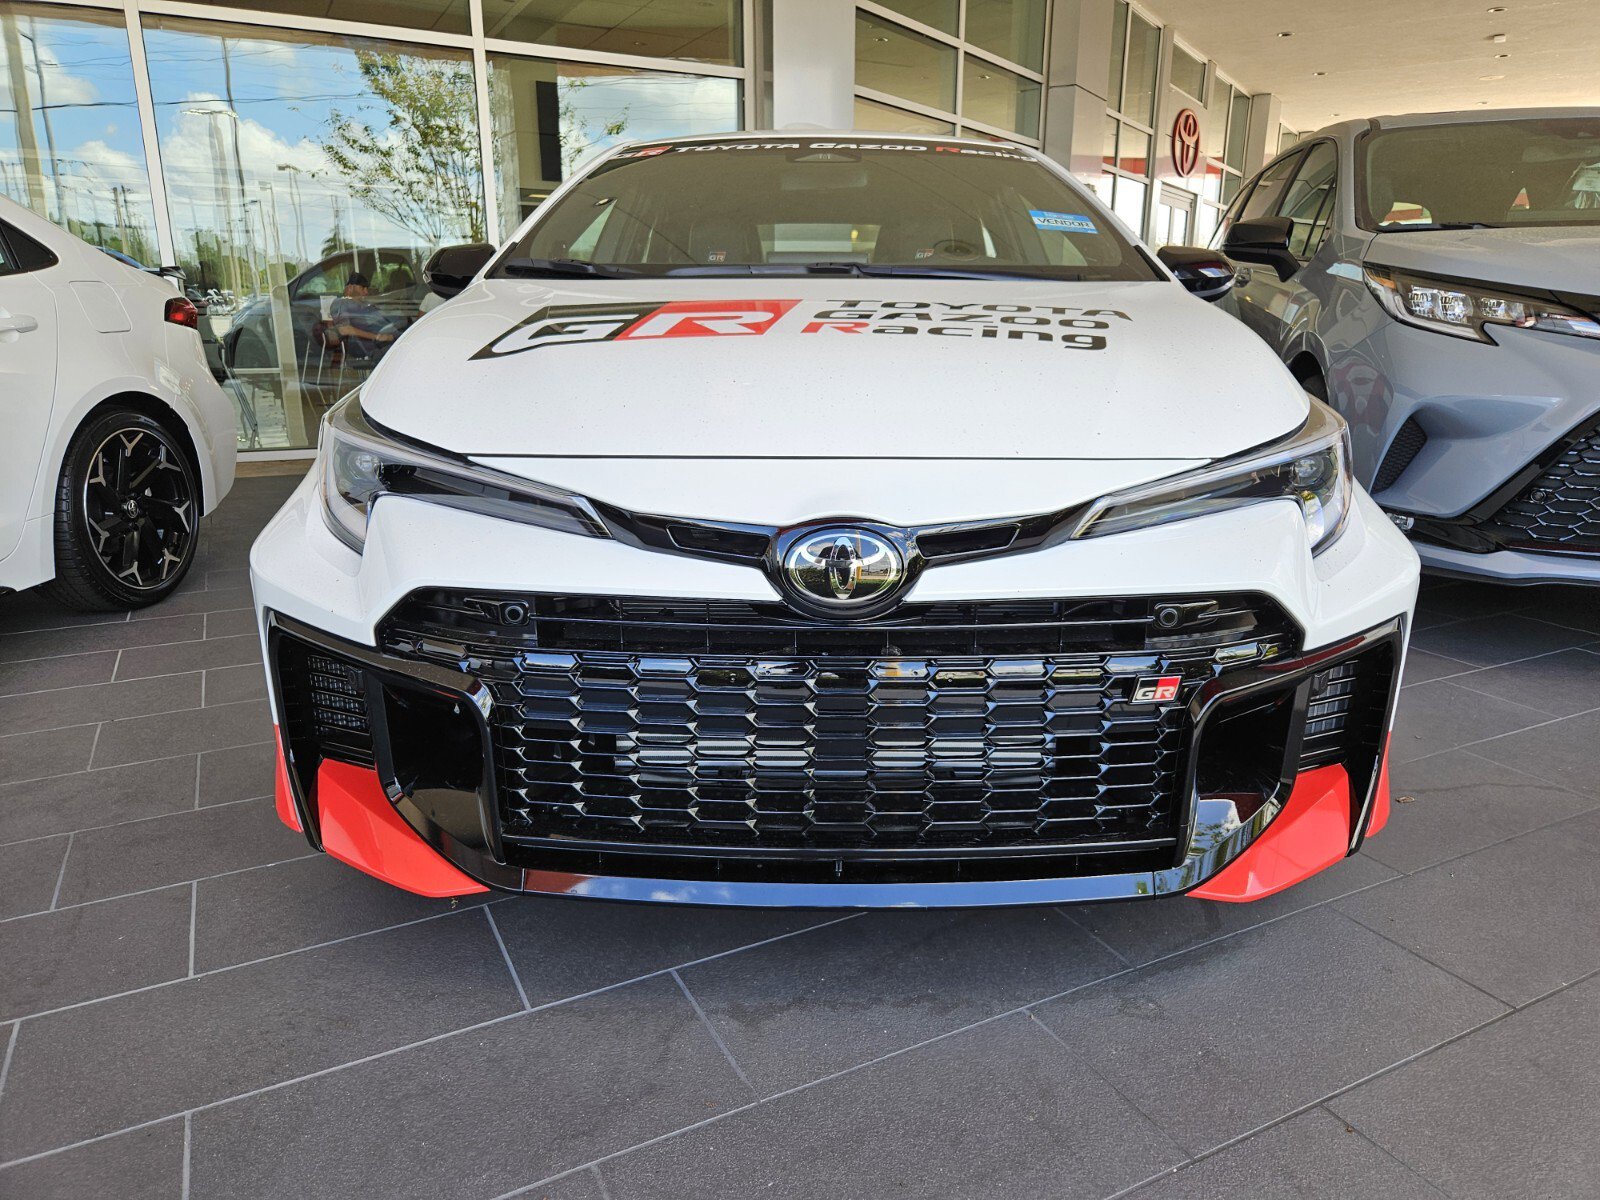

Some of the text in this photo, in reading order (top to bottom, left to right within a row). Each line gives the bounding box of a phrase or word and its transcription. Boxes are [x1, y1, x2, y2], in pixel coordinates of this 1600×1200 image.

[675, 143, 799, 153] TOYOTA
[809, 142, 928, 151] GAZOO
[935, 145, 1038, 163] Racing
[1037, 217, 1090, 228] VENDOR
[813, 309, 1110, 329] GAZOO
[826, 299, 1133, 322] TOYOTA
[491, 311, 775, 354] GR
[800, 321, 1107, 350] Racing
[1135, 686, 1176, 700] GR
